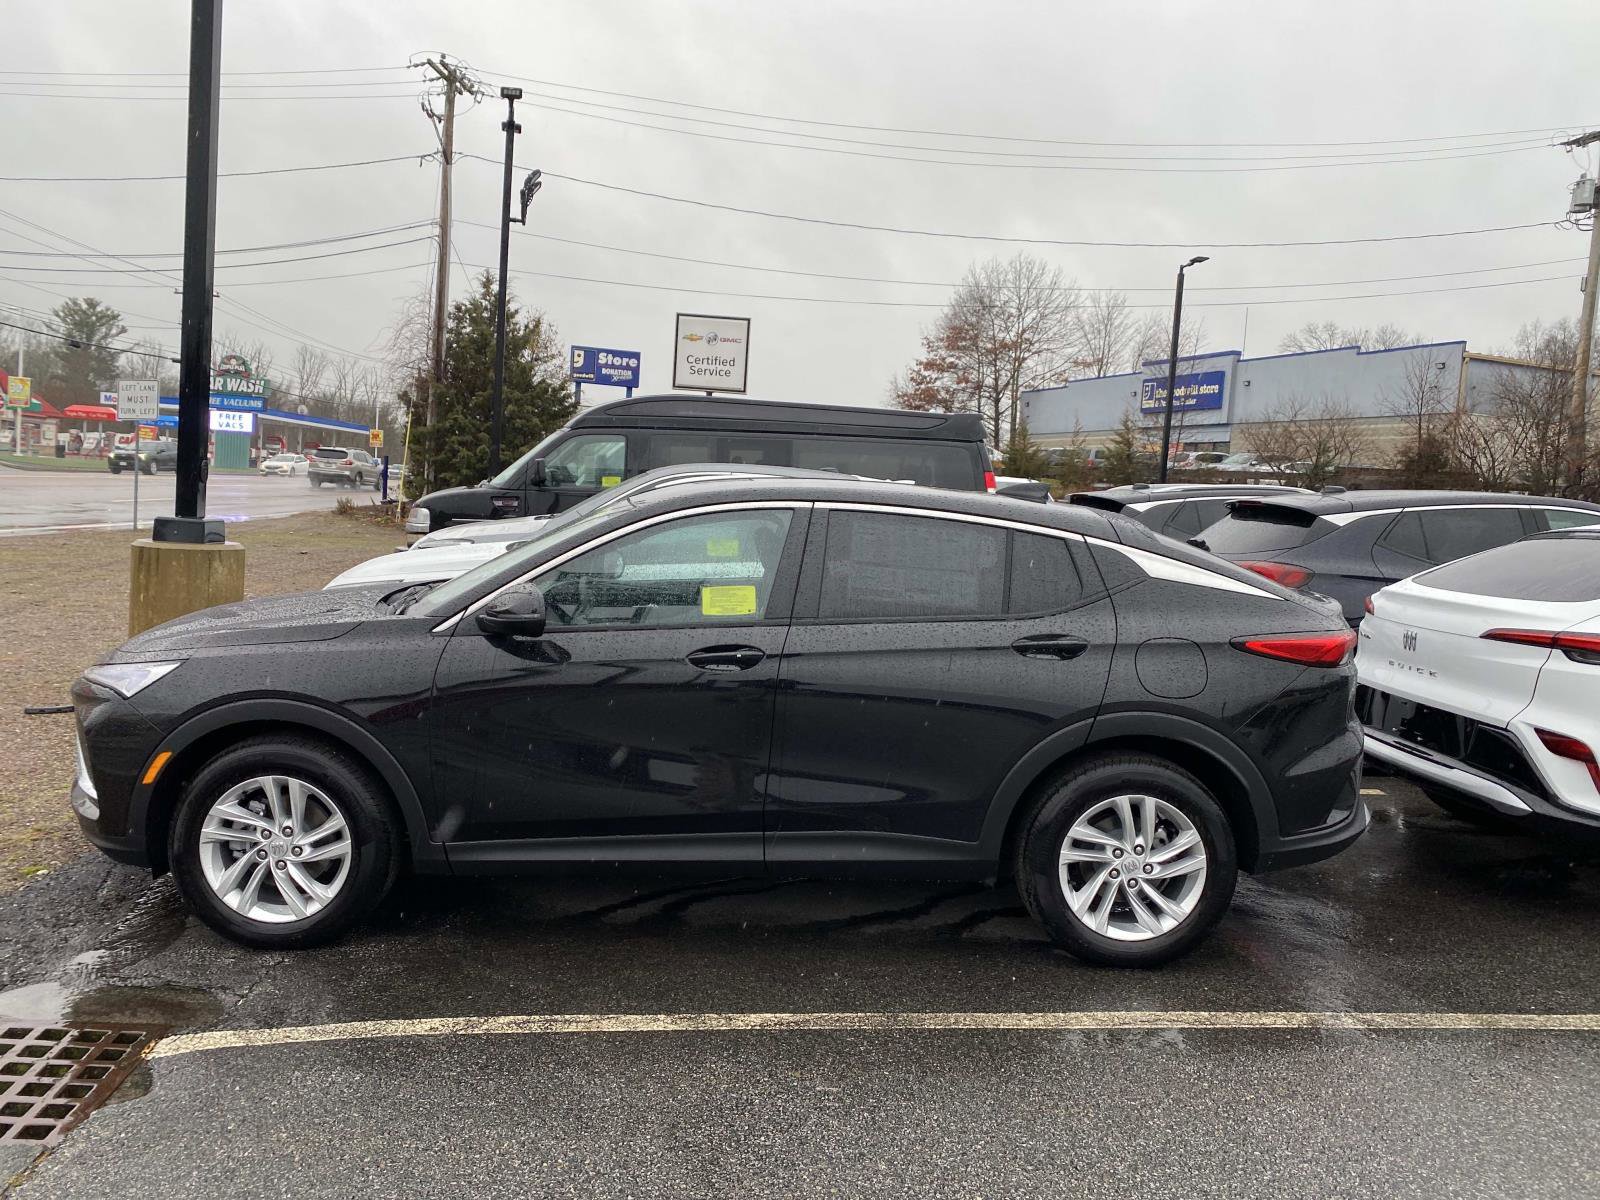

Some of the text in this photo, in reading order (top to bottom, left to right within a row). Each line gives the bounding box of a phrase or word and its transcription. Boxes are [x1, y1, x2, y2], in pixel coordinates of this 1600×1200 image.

[598, 352, 638, 368] Store
[686, 354, 736, 367] Certified
[689, 365, 731, 377] Service
[121, 384, 137, 392] LEFT
[210, 377, 265, 393] AR WASH
[1199, 383, 1219, 394] store
[127, 395, 149, 404] MUST
[223, 398, 264, 408] VACUUMS
[219, 413, 244, 421] FREE
[219, 422, 245, 430] VACS
[1388, 660, 1438, 678] BUICK
